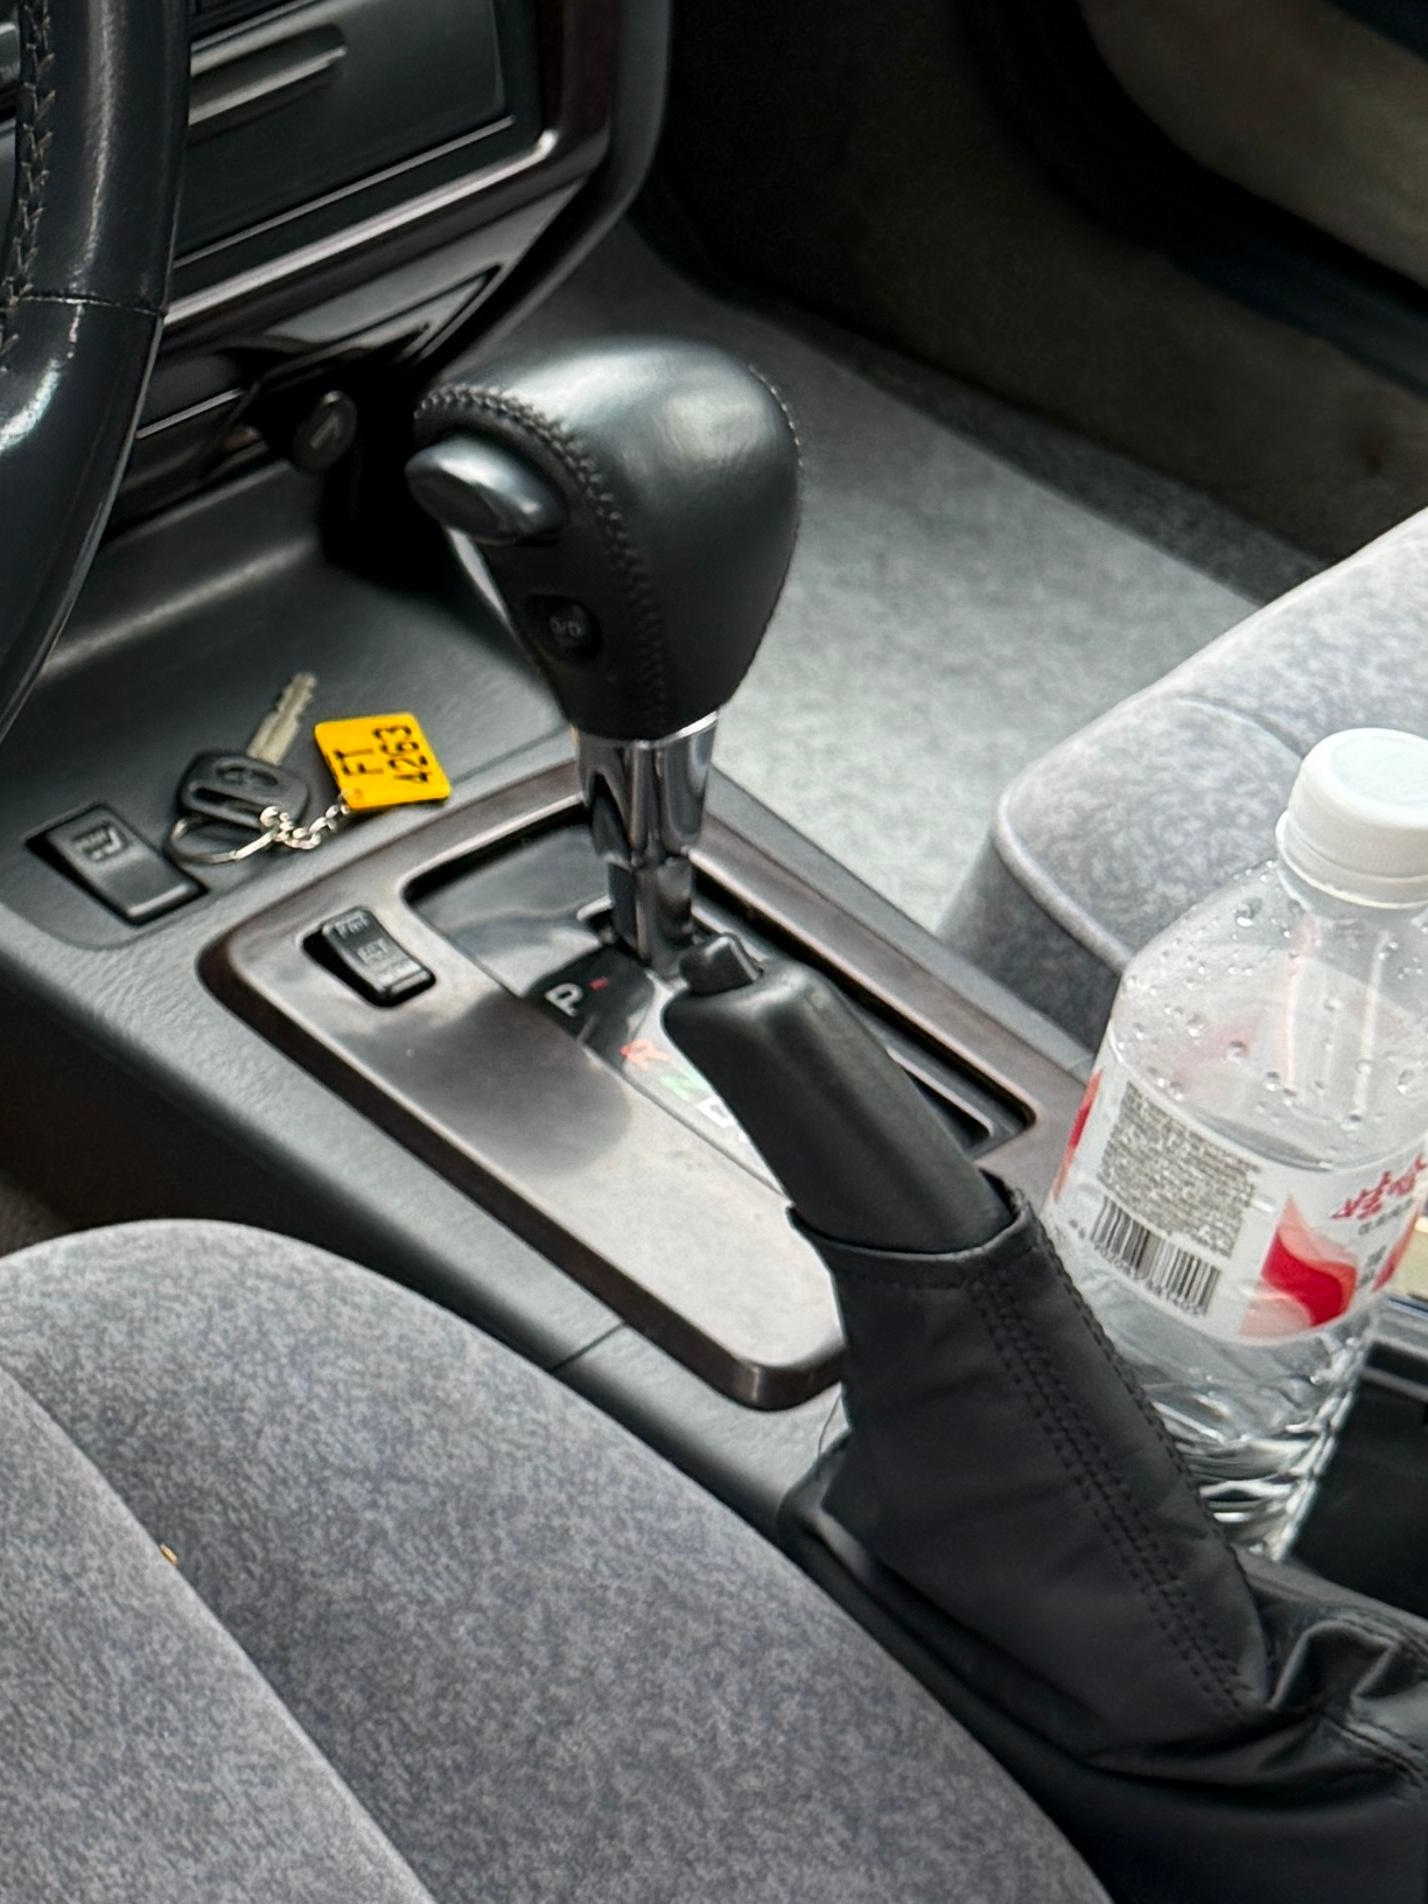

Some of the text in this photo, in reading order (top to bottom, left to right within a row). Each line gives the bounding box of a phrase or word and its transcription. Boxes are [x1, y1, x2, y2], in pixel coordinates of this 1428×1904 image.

[334, 746, 385, 780] FT
[373, 724, 431, 785] 4263
[545, 982, 584, 1017] P
